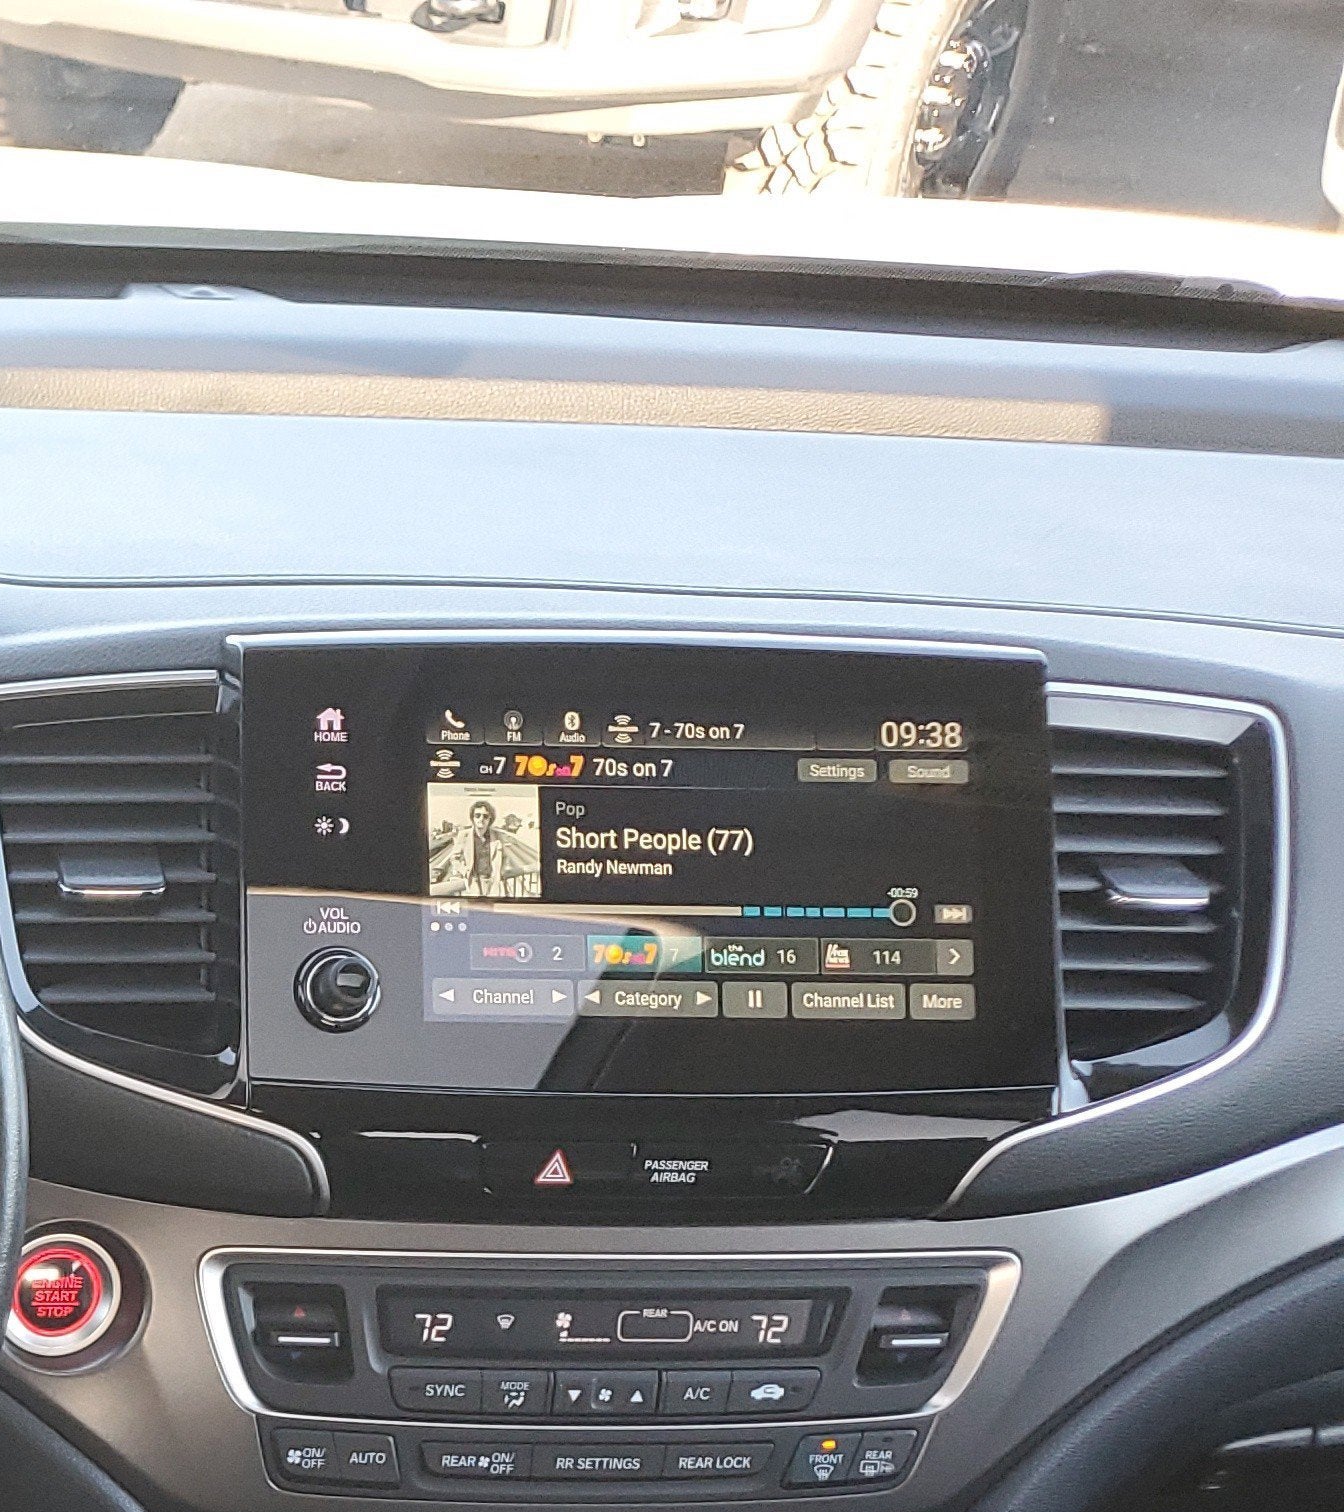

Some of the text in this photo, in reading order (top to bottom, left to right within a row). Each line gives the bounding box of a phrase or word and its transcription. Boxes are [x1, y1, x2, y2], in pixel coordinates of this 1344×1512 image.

[314, 732, 349, 743] HOME
[441, 730, 470, 741] Phone
[507, 732, 521, 742] FM
[649, 723, 661, 738] 7
[675, 723, 705, 739] 70s
[709, 727, 730, 739] on
[733, 724, 745, 739] 7
[880, 721, 963, 748] 09:38
[559, 733, 585, 743] Audio
[593, 759, 628, 777] 70s
[633, 762, 657, 777] on
[660, 759, 673, 777] 7
[810, 764, 864, 780] Settings
[907, 765, 951, 778] Sound
[315, 781, 347, 792] BACK
[555, 802, 585, 818] Pop
[555, 827, 754, 856] Short People (77)
[556, 858, 673, 878] Randy Newman
[319, 907, 349, 920] VOL
[318, 921, 361, 934] AUDIO
[552, 947, 562, 961] 2
[711, 948, 765, 967] blend
[776, 950, 796, 964] 16
[873, 950, 901, 965] 114
[472, 989, 535, 1005] Channel
[615, 990, 682, 1009] Category
[802, 993, 895, 1008] Channel List
[922, 995, 963, 1009] More
[644, 1160, 709, 1171] PASSENGER
[650, 1172, 696, 1183] AIRBAG
[35, 1290, 79, 1301] START
[36, 1307, 73, 1317] STOP
[643, 1308, 667, 1318] REAR
[415, 1313, 453, 1343] 72
[694, 1320, 739, 1333] A/C ON
[751, 1314, 789, 1343] 72
[425, 1384, 466, 1398] SYNC
[500, 1381, 530, 1390] MODE
[684, 1387, 710, 1400] A/C
[349, 1453, 386, 1464] AUTO
[442, 1455, 475, 1467] REAR
[809, 1453, 844, 1465] FRONT
[865, 1450, 893, 1460] REAR
[301, 1459, 325, 1469] OFF
[490, 1464, 514, 1474] OFF
[556, 1457, 640, 1470] RR SETTINGS
[679, 1456, 752, 1469] REAR LOCK
